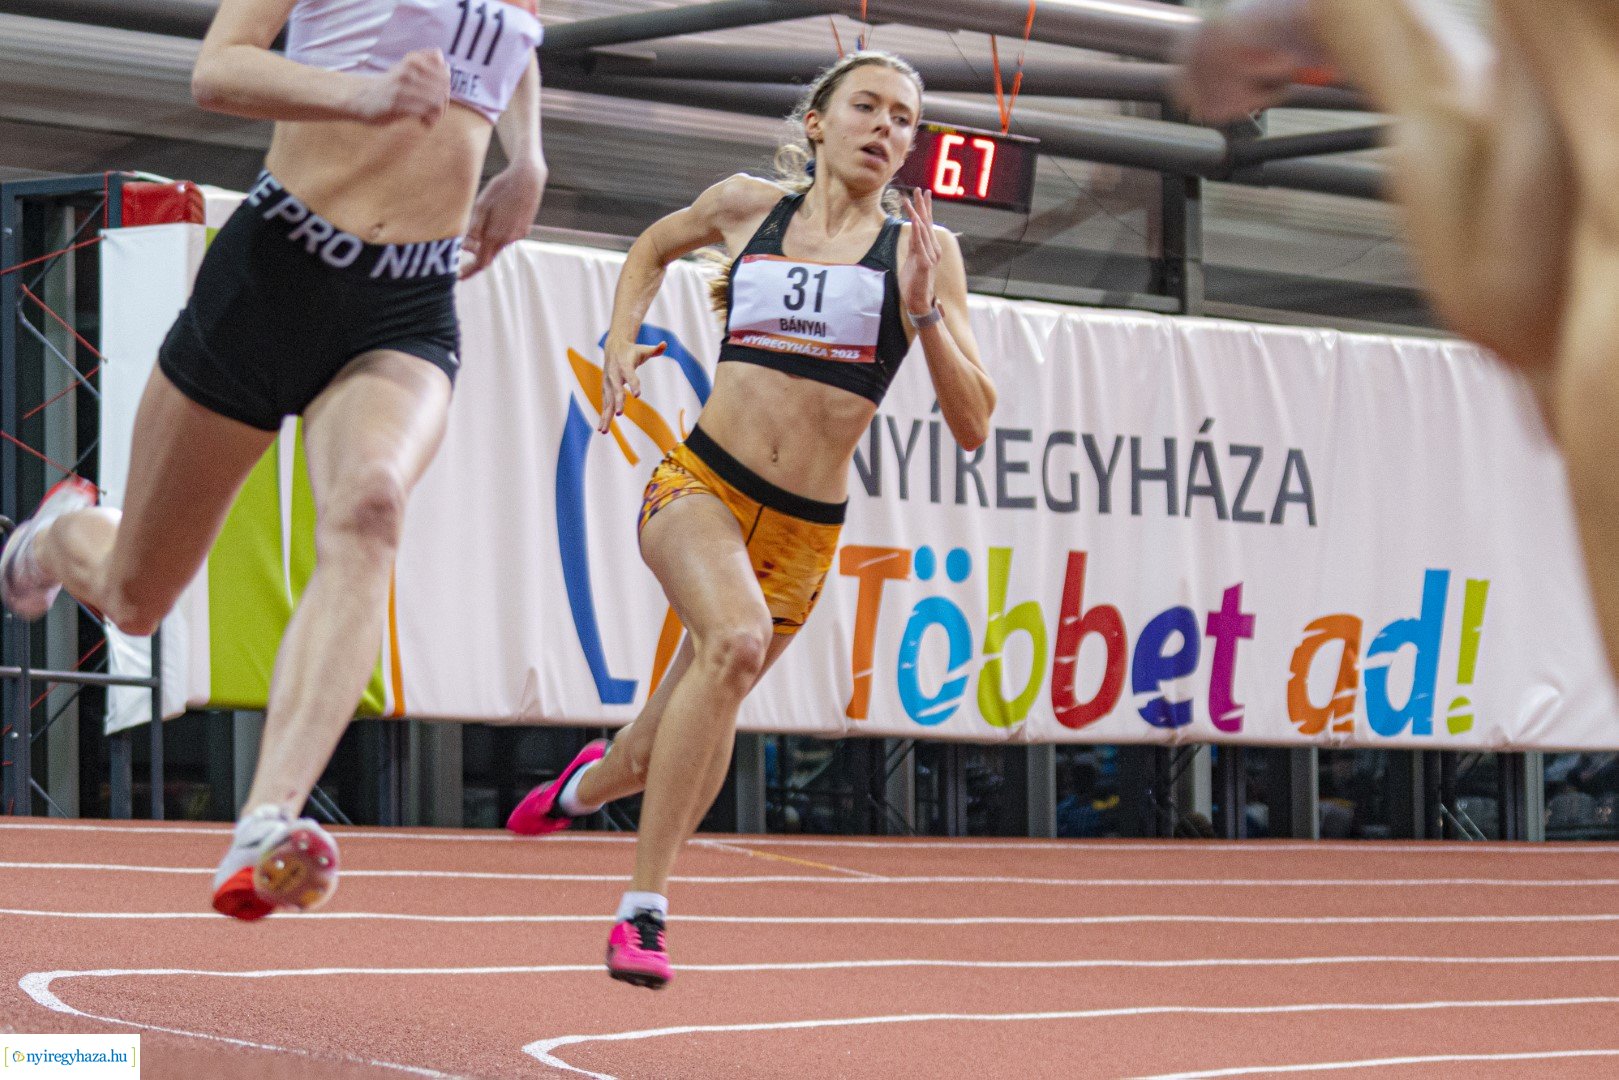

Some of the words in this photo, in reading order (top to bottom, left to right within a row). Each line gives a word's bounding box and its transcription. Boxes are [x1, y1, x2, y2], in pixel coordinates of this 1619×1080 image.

[449, 0, 503, 66] 111
[933, 134, 994, 198] 6.7
[263, 195, 363, 268] PRO
[783, 266, 828, 313] 31
[741, 335, 828, 357] NYÍREGYHÁZA
[830, 349, 860, 361] 2023
[780, 316, 827, 338] BÁNYAI
[853, 397, 1317, 527] NYÍREGYHÁZA
[839, 544, 1256, 733] Többet
[1287, 568, 1490, 737] ad!
